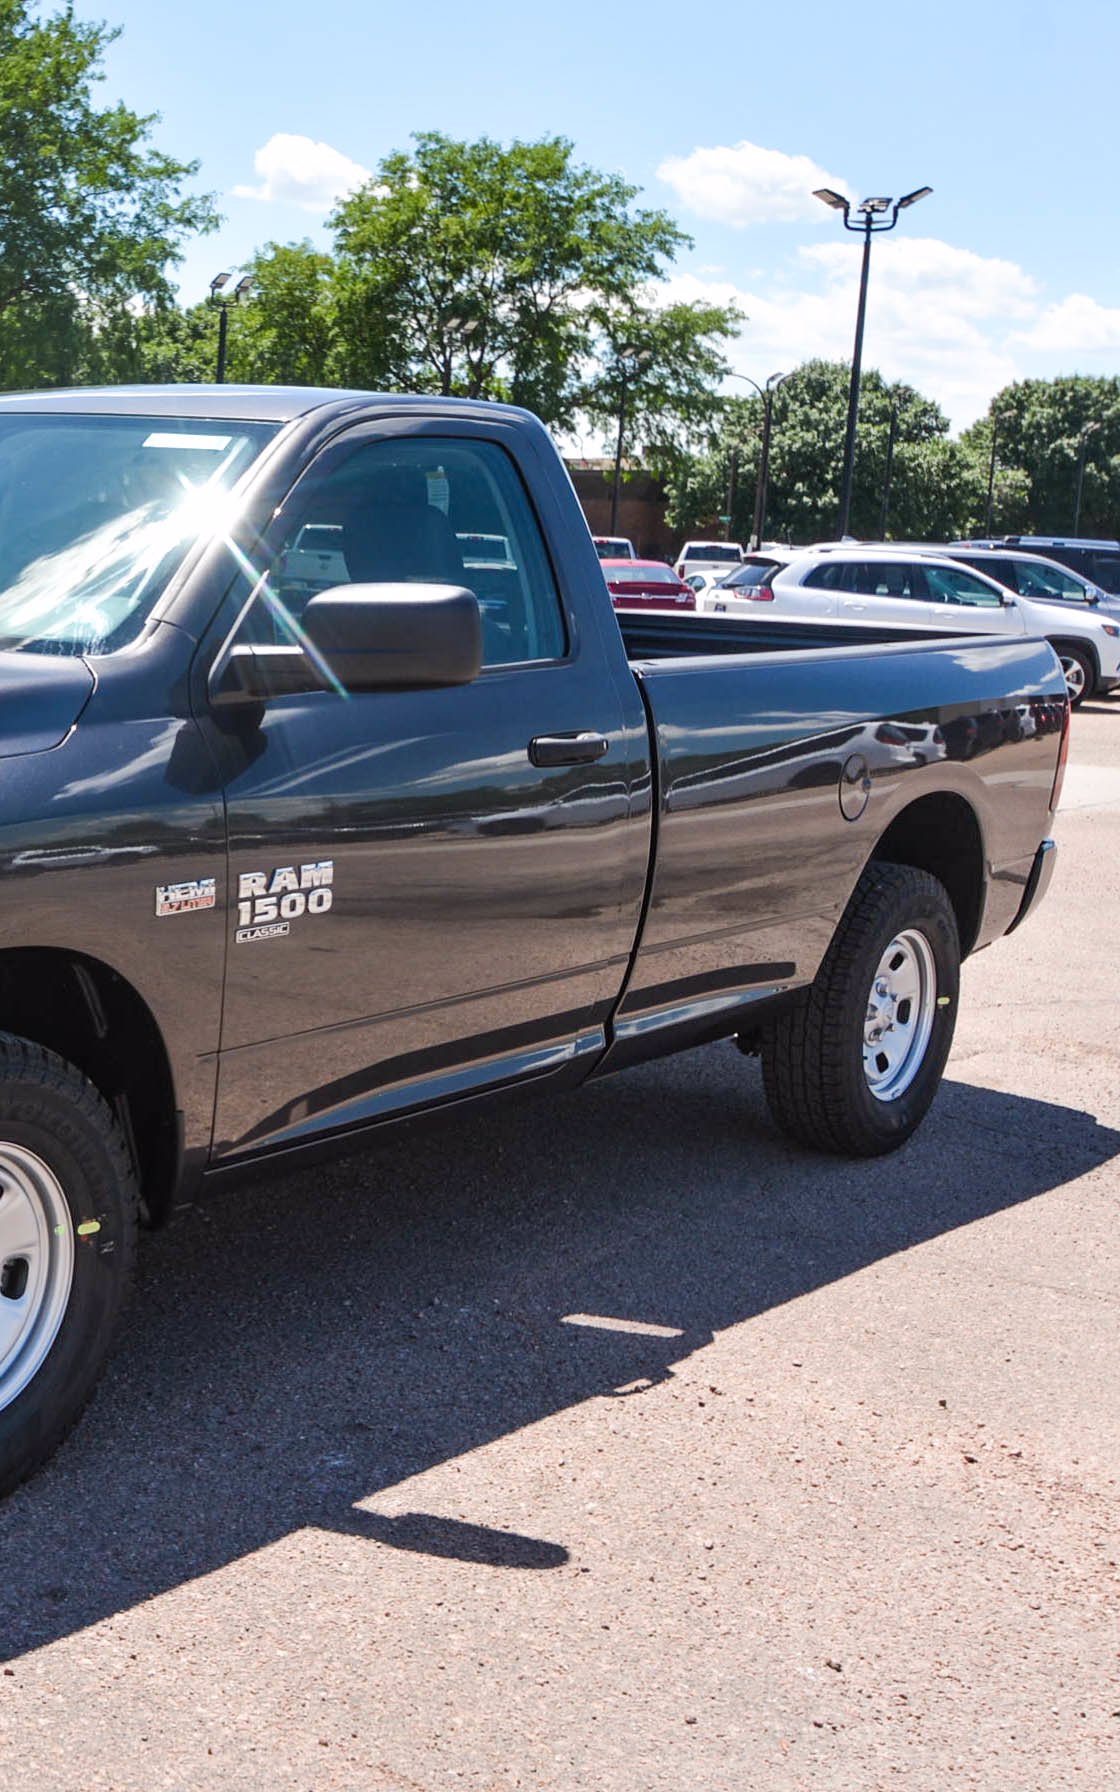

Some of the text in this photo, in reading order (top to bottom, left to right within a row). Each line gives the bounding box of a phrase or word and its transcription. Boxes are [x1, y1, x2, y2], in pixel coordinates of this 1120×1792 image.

[159, 879, 216, 903] HEMI
[238, 860, 334, 898] RAM
[238, 888, 333, 926] 1500
[238, 923, 289, 942] CLASSIC
